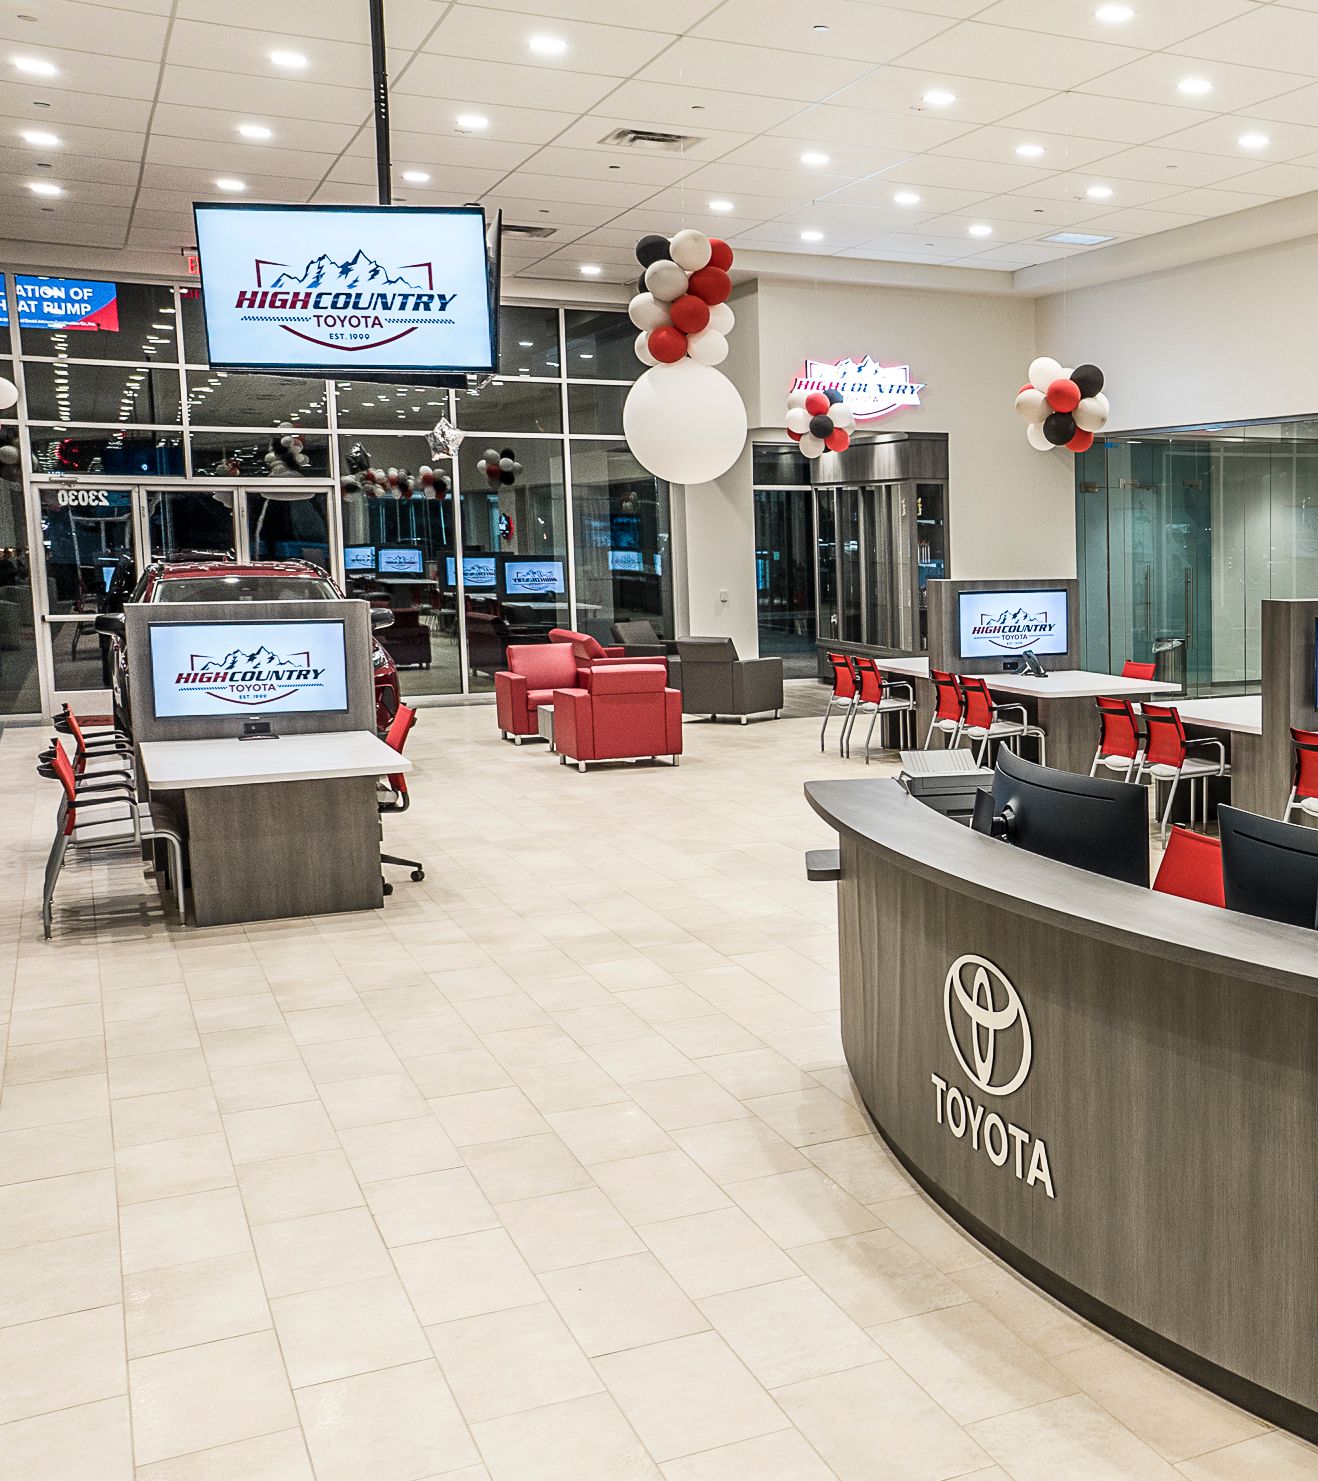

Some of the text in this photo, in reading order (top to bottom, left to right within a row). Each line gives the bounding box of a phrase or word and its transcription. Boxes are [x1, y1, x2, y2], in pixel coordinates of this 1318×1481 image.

[0, 284, 93, 300] ATION OF
[235, 290, 458, 312] HIGHCOUNTRY
[313, 314, 384, 329] TOYOTA
[971, 623, 1056, 635] HIGHCOUNTRY
[1001, 633, 1028, 641] TOYOTA
[175, 668, 326, 684] HIGHCOUNTRY
[229, 683, 276, 693] TOYOTA
[931, 1072, 1056, 1199] TOYOTA
